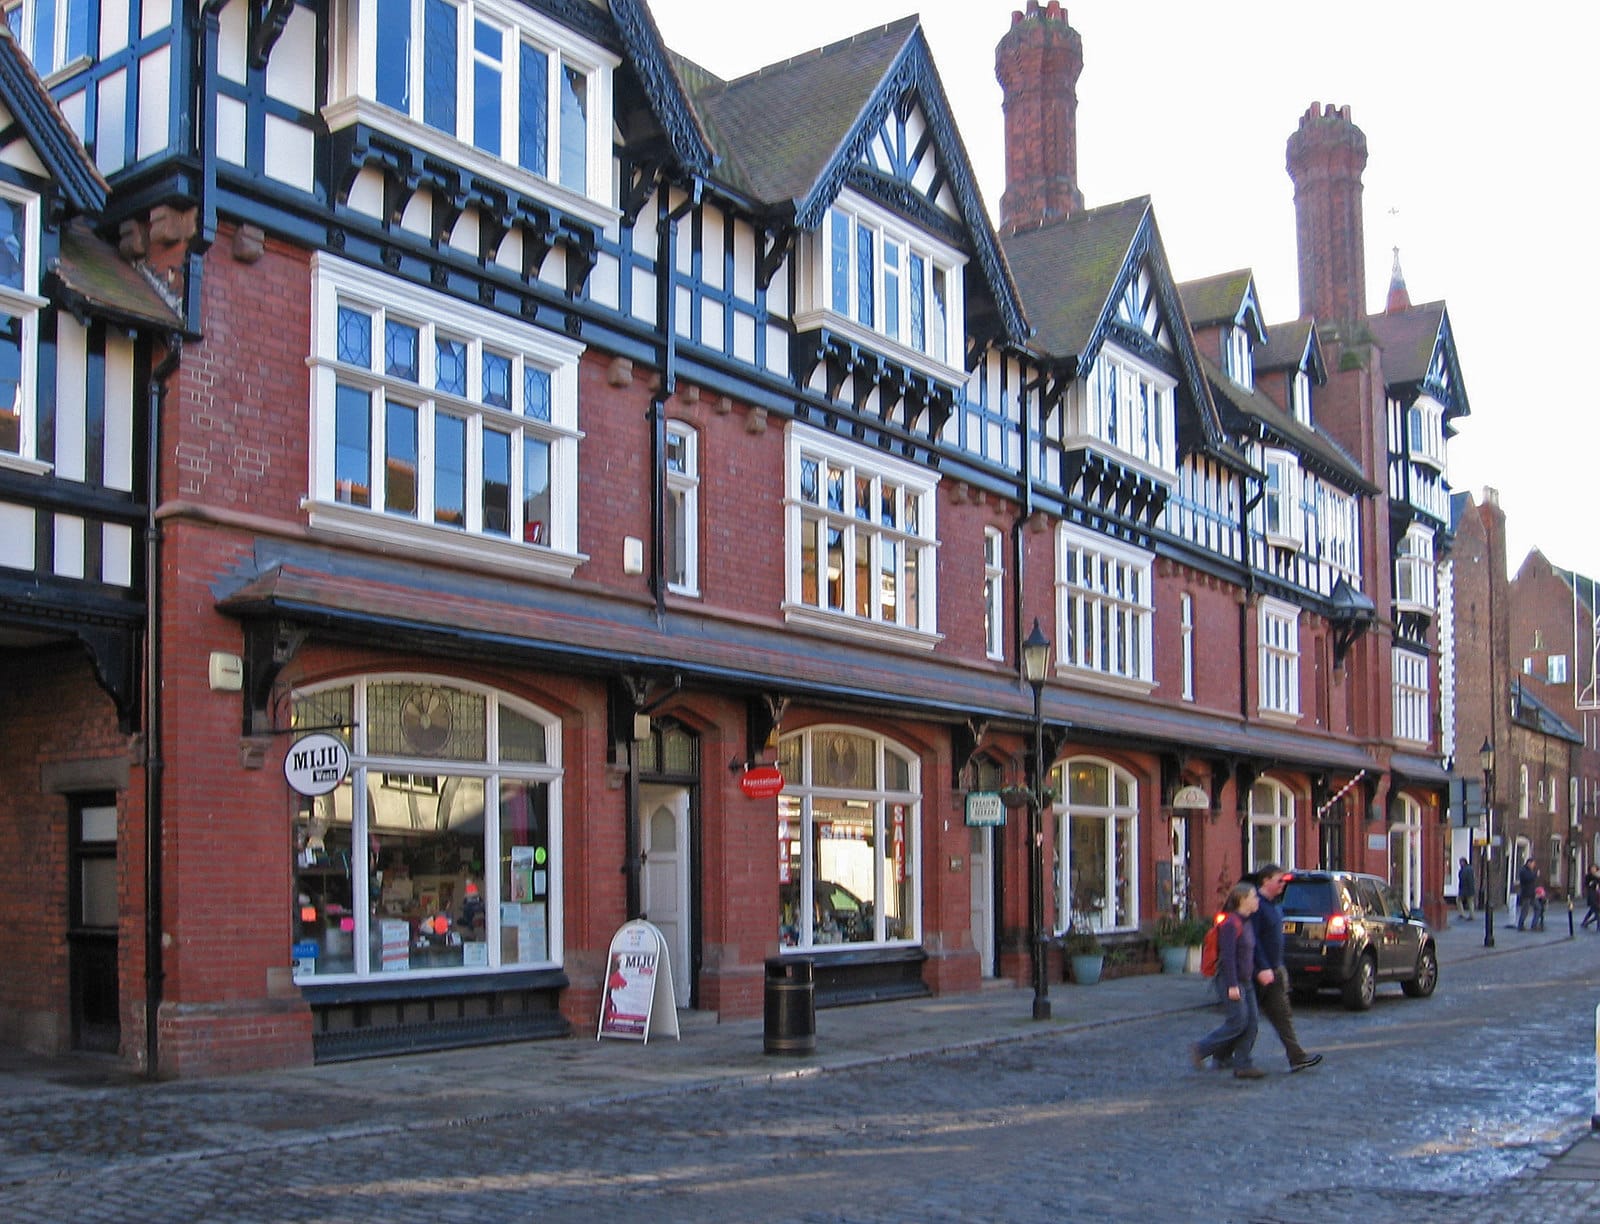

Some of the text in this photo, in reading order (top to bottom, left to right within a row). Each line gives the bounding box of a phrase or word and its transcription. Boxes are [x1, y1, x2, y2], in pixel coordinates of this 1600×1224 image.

[294, 746, 338, 770] MIJU
[820, 824, 865, 840] SALE
[894, 804, 904, 881] SALE
[626, 955, 655, 968] MIJU
